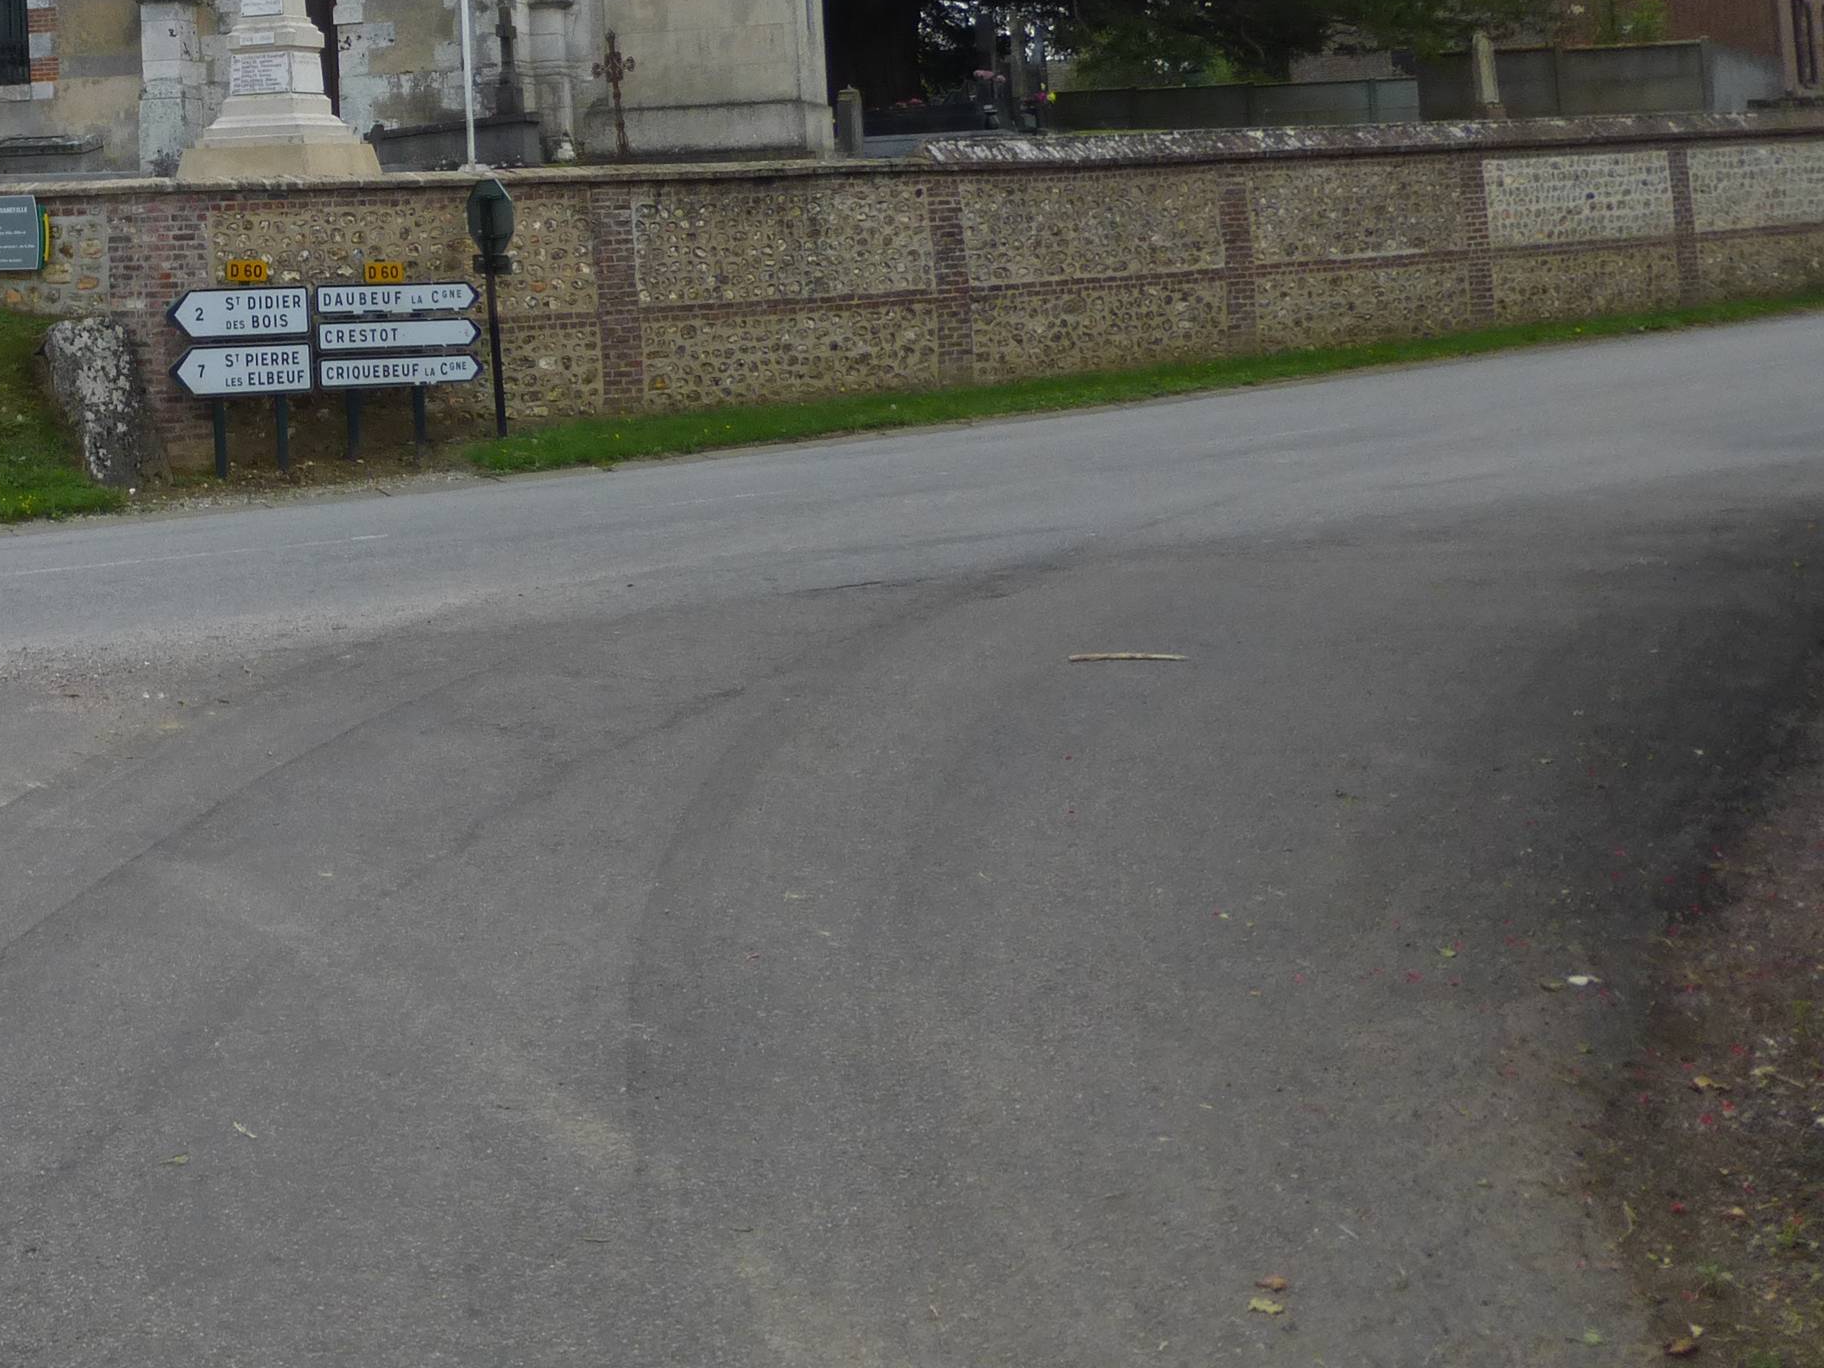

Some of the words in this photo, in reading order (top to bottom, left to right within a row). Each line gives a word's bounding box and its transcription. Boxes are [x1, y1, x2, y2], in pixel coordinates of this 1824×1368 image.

[230, 264, 239, 278] D
[244, 264, 263, 278] 60
[368, 266, 377, 280] D
[381, 265, 399, 279] 60
[247, 295, 301, 311] DIDIER
[323, 291, 402, 307] DAUBEUF
[411, 295, 423, 305] LA
[195, 307, 204, 322] 2
[226, 320, 246, 330] DES
[251, 314, 289, 329] BOIS
[325, 328, 399, 344] CRESTOT
[245, 351, 300, 368] PIERRE
[197, 364, 206, 378] 7
[225, 377, 244, 388] LES
[248, 370, 305, 386] ELBEUF
[326, 363, 420, 380] CRIQUEBEUF
[424, 368, 436, 377] LA
